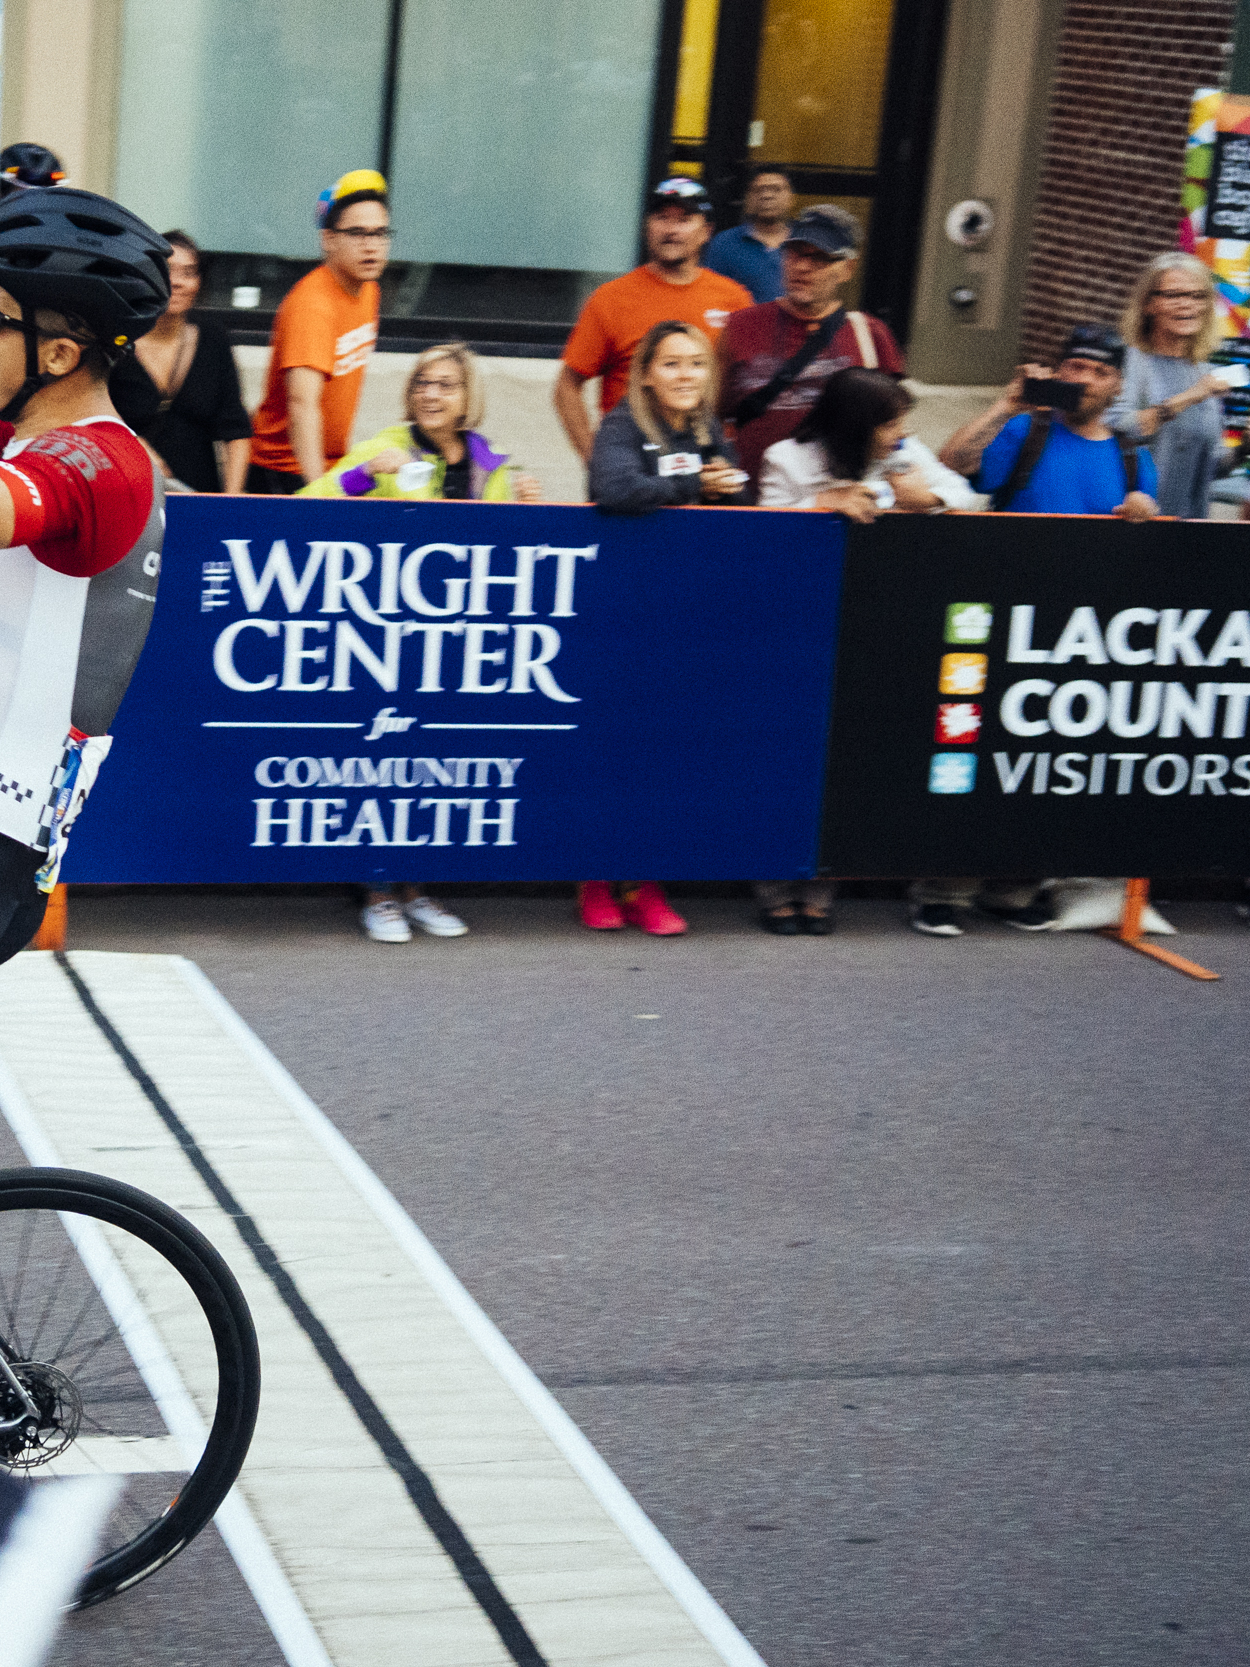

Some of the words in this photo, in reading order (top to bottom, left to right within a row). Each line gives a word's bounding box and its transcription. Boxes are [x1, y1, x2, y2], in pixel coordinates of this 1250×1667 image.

[221, 539, 600, 626] WRIGHT
[213, 618, 582, 704] CENTER
[1006, 604, 1250, 668] LACKA
[363, 706, 418, 742] for
[1000, 678, 1250, 740] COUNT
[254, 756, 525, 789] COMMUNITY
[250, 797, 521, 848] HEALTH
